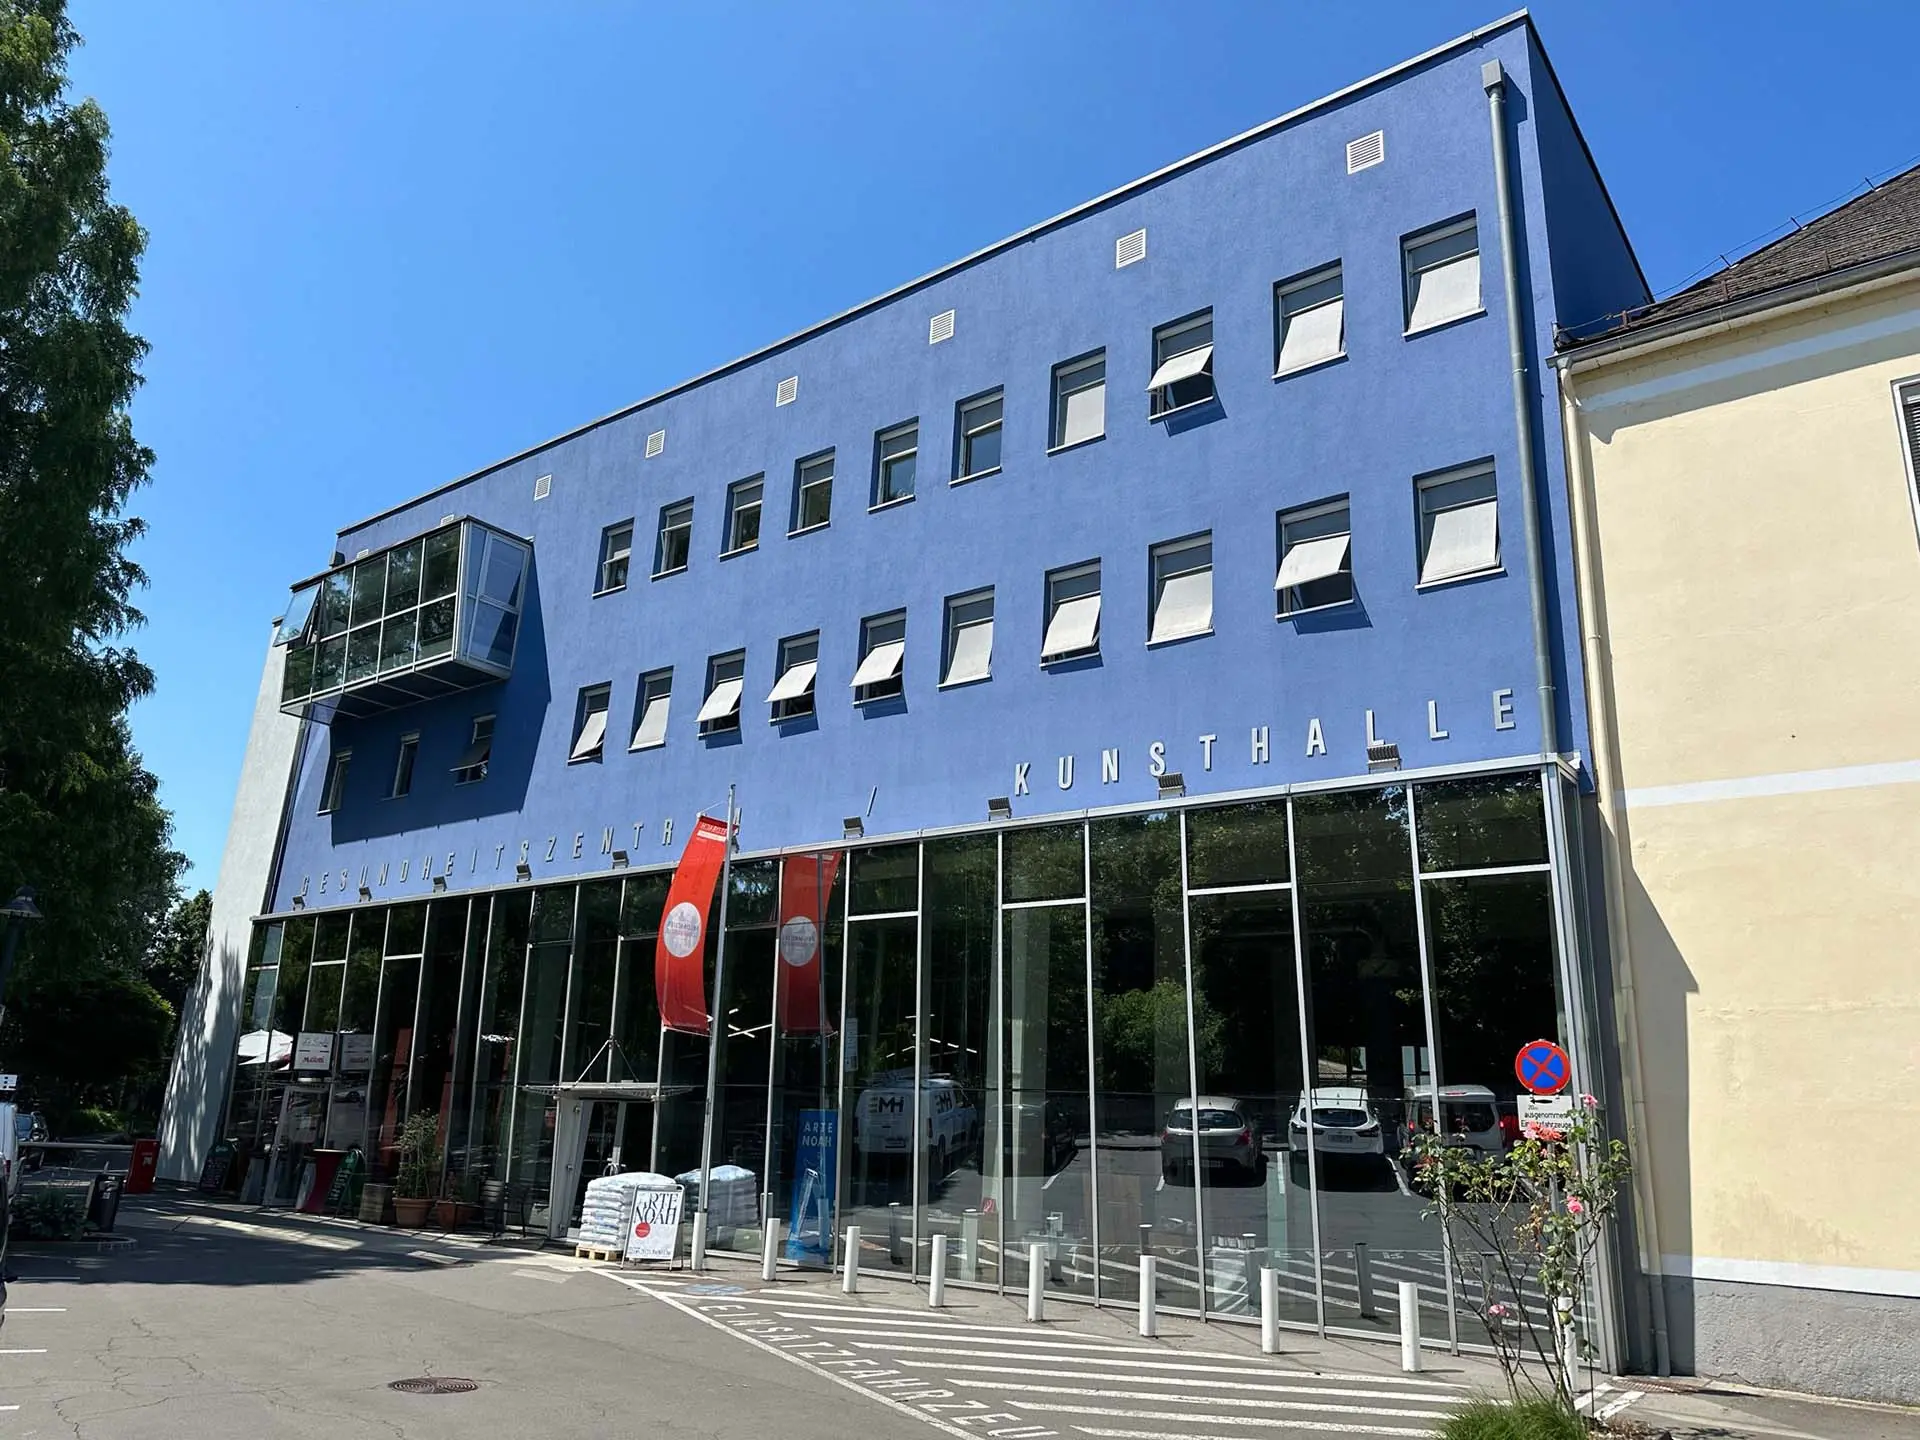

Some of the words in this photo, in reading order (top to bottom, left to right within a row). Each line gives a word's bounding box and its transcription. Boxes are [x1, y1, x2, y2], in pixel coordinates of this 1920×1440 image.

[301, 808, 742, 897] GESUNDHEITSZENTR
[1014, 688, 1516, 796] KUNSTHALLE
[803, 1121, 833, 1134] ARTE
[1520, 1120, 1572, 1129] Eitzfahrzeuge
[801, 1135, 832, 1147] NOAH
[634, 1206, 677, 1225] NOAH
